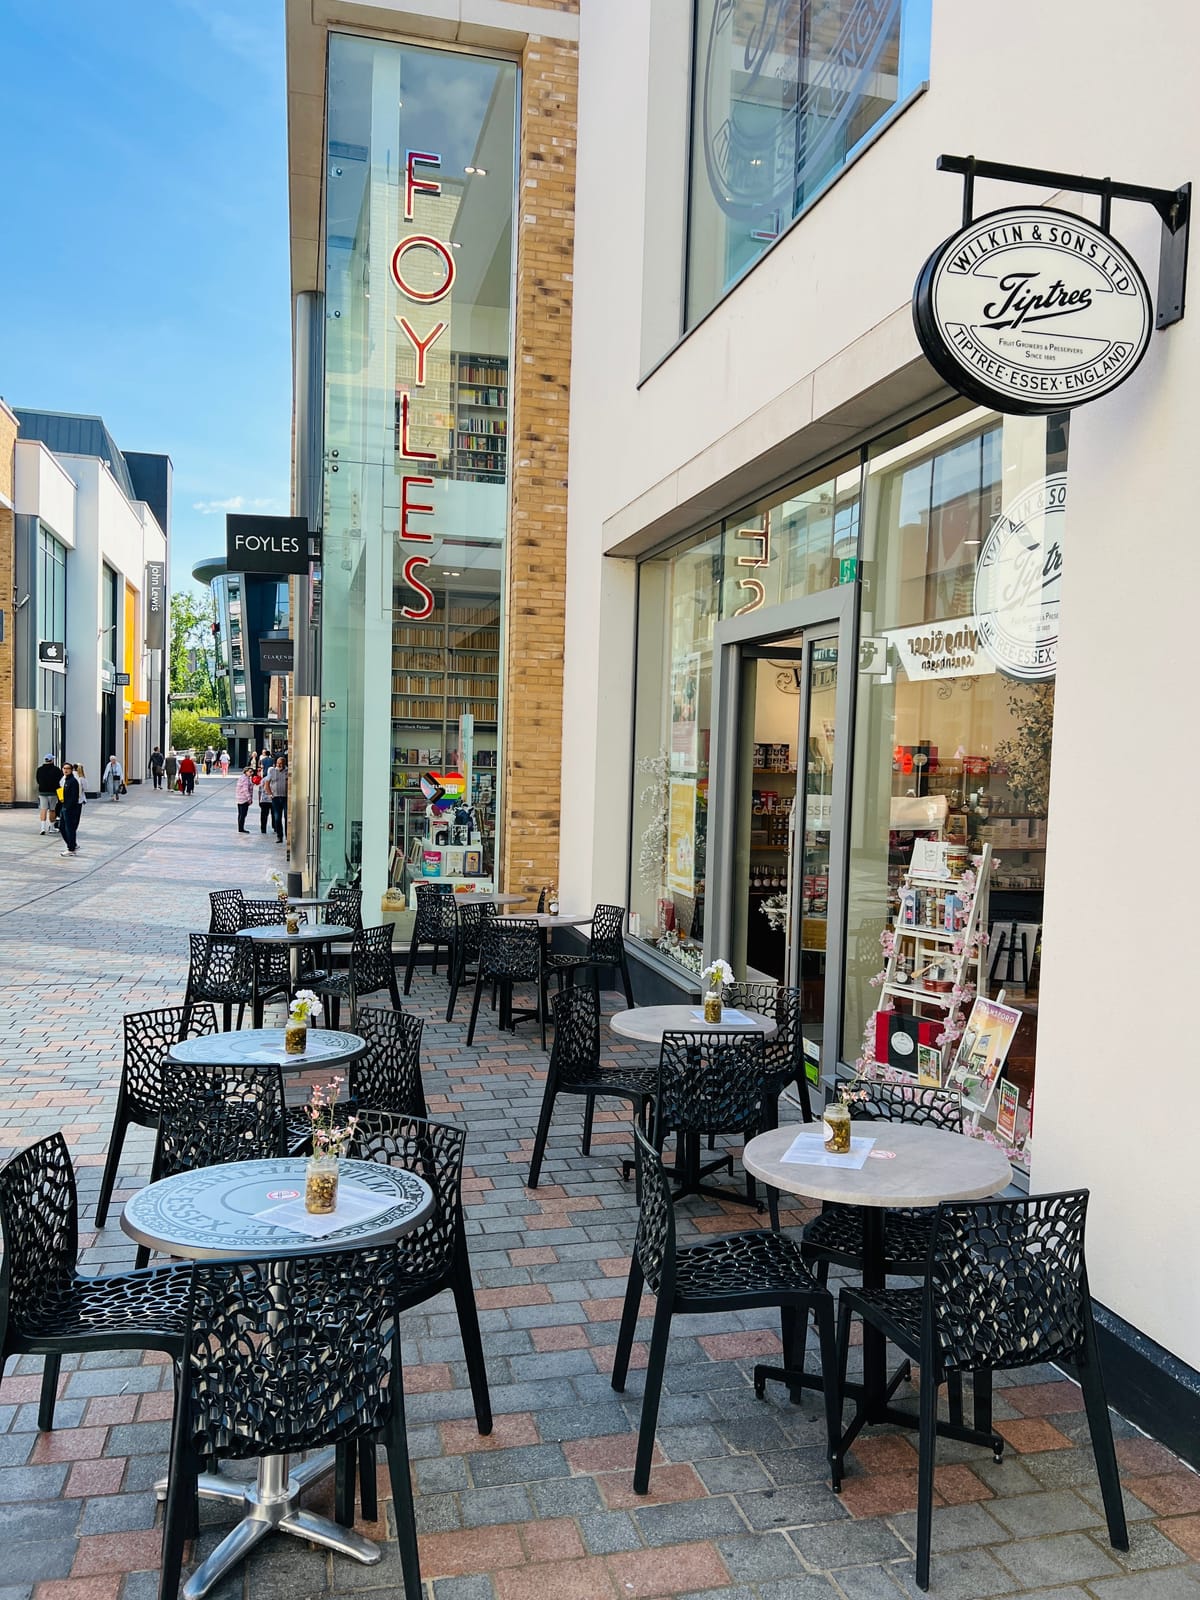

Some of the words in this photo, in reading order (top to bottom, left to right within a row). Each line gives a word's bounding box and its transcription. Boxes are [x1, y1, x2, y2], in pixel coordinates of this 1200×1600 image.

[953, 225, 1023, 271] WILKIN
[1031, 224, 1042, 241] &
[1048, 227, 1099, 259] SONS
[1101, 255, 1129, 292] LTD
[980, 271, 1093, 330] Tiptree
[390, 149, 457, 620] FOYLES
[952, 327, 1007, 379] TIPTREE
[1010, 373, 1059, 391] ESSEX
[1066, 344, 1127, 389] ENGLAND
[235, 535, 300, 553] FOYLES
[150, 564, 161, 585] John
[151, 587, 161, 612] Lewis
